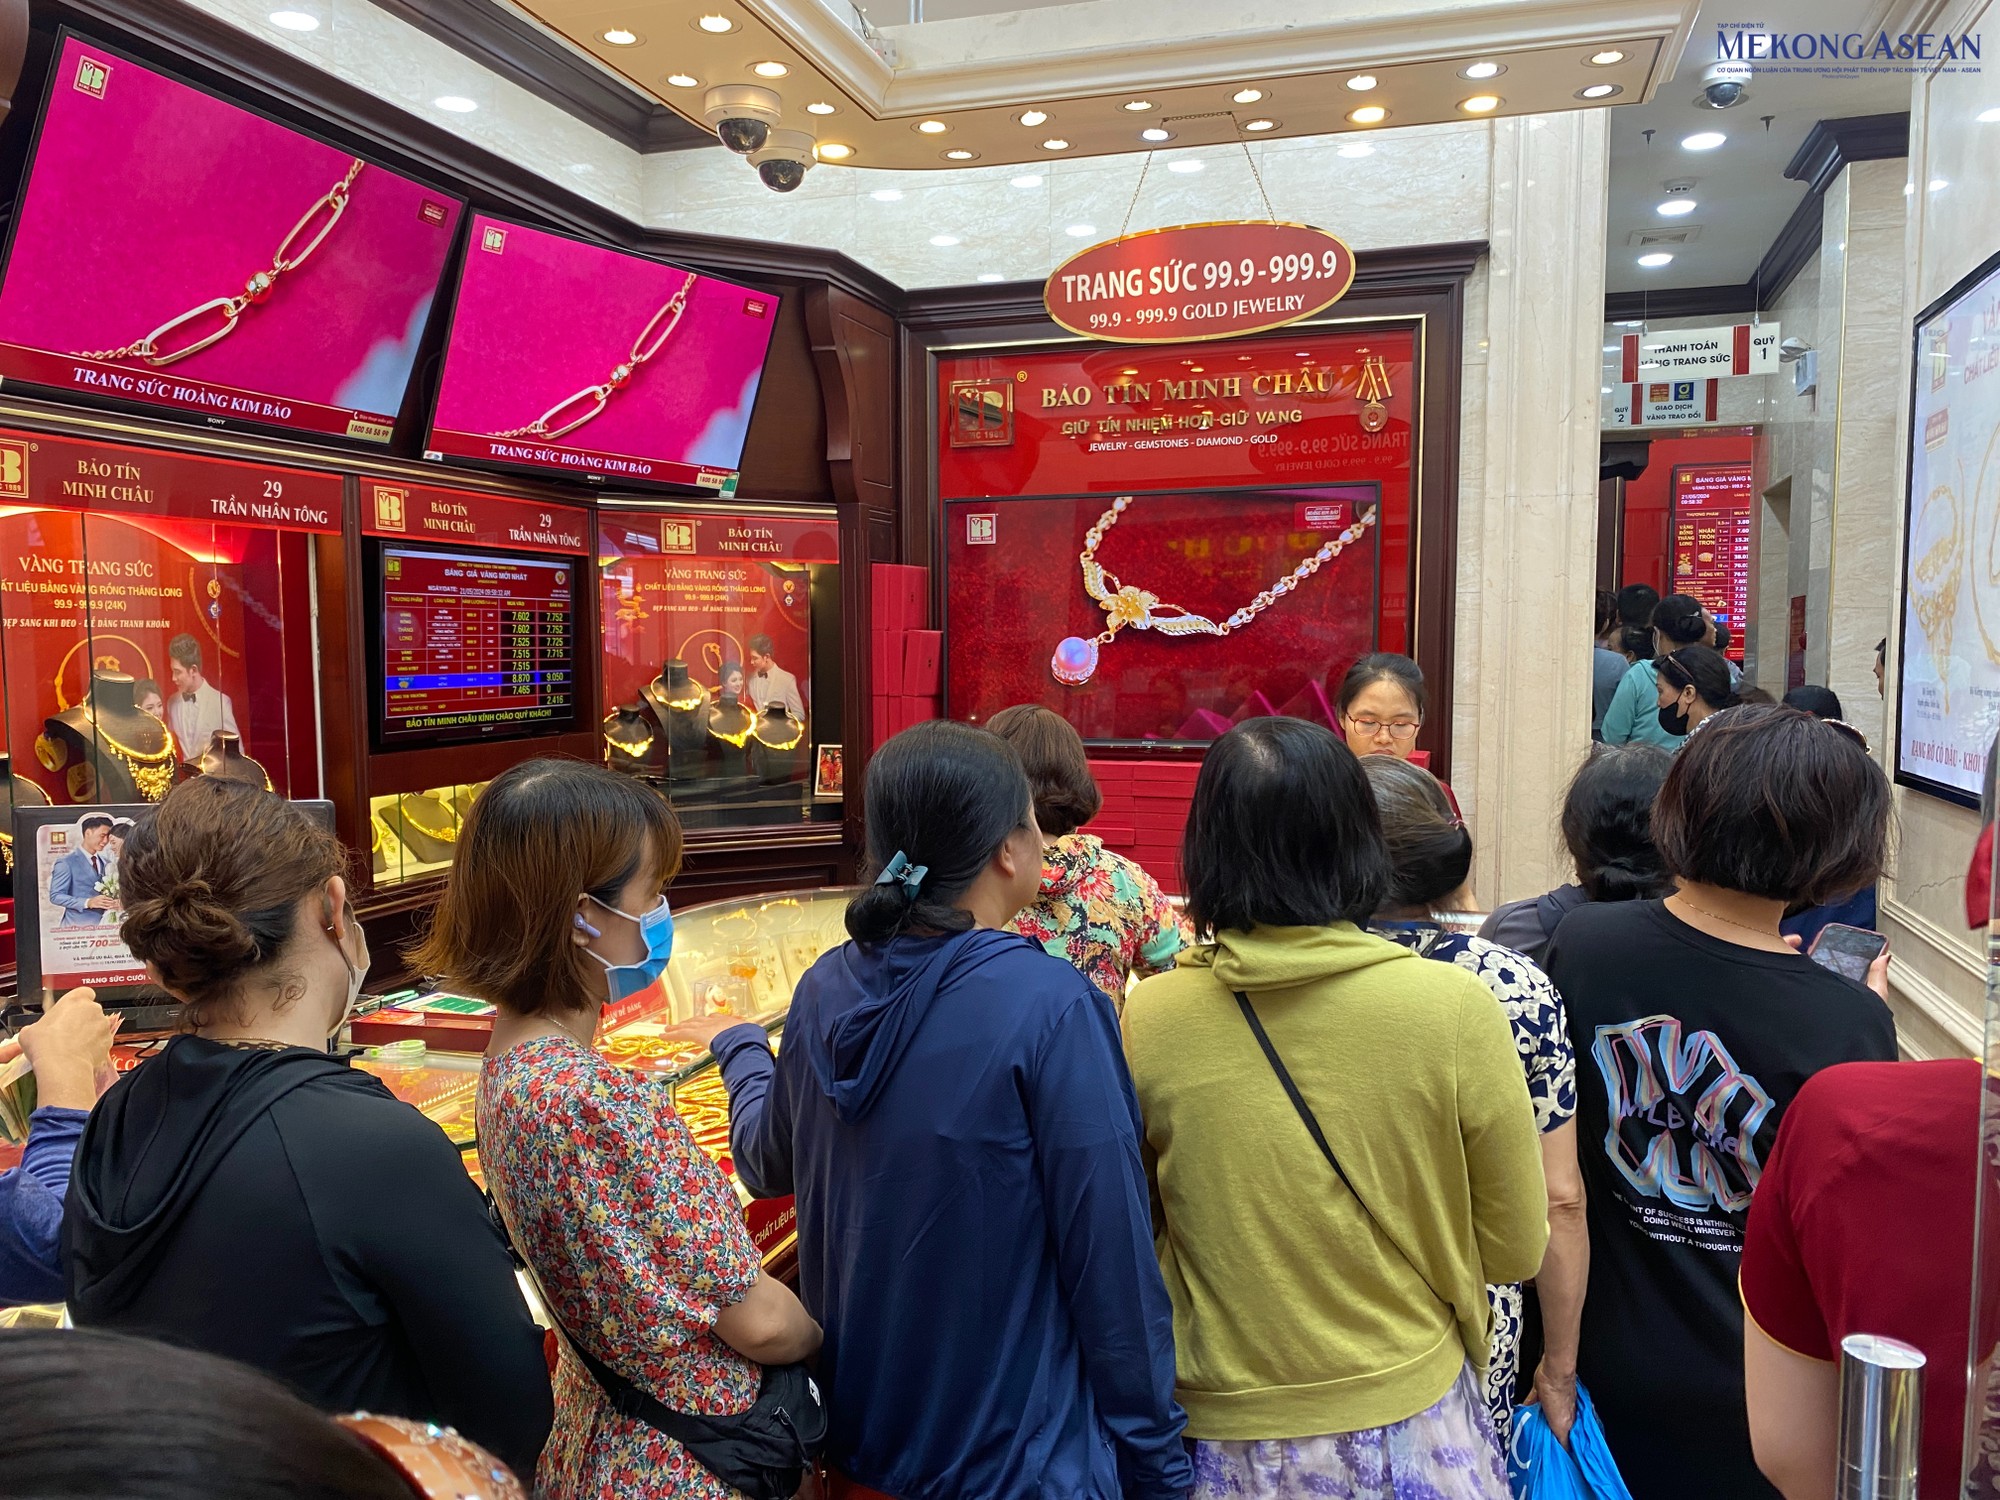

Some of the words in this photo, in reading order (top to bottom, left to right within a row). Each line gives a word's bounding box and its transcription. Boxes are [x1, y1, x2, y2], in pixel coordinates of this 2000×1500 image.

[1062, 268, 1143, 303] TRANG
[1149, 258, 1197, 295] SỨC
[1090, 312, 1121, 329] 99.9
[1136, 307, 1178, 325] 999.9
[1182, 302, 1228, 320] GOLD
[1232, 295, 1305, 318] JEWELRY
[1691, 341, 1718, 351] TOÁN
[1754, 336, 1775, 346] QUỸ
[1673, 357, 1707, 366] TRANG
[1710, 353, 1731, 363] SỨC
[1762, 348, 1767, 360] 1
[73, 367, 134, 391] TRANG
[136, 376, 171, 398] SỨC
[173, 385, 229, 408] HOÀNG
[230, 397, 261, 414] KIM
[264, 401, 292, 420] BẢO
[1041, 383, 1092, 408] BẢO
[1103, 379, 1151, 405] TÍN
[1163, 377, 1242, 401] MINH
[1252, 367, 1335, 396] CHÂU
[207, 417, 226, 425] SONY
[1219, 409, 1250, 426] GIỮ
[1618, 414, 1624, 422] 2
[1088, 441, 1127, 452] JEWELRY
[1134, 438, 1189, 450] GEMSTONES
[1196, 436, 1243, 447] DIAMOND
[1250, 434, 1278, 444] GOLD
[489, 443, 533, 459] TRANG
[534, 447, 559, 463] SỨC
[561, 454, 602, 468] HOÀNG
[604, 460, 626, 472] KIM
[629, 461, 652, 474] BẢO
[77, 458, 111, 477] BẢO
[114, 461, 141, 480] TÍN
[63, 480, 106, 500] MINH
[110, 485, 154, 504] CHÂU
[263, 480, 283, 499] 29
[211, 494, 247, 517] TRẦN
[251, 502, 290, 522] NHÂN
[293, 505, 328, 524] TÔNG
[431, 501, 450, 515] BẢO
[451, 503, 468, 516] TÍN
[424, 517, 450, 532] MINH
[450, 518, 476, 534] CHÂU
[539, 513, 552, 528] 29
[509, 525, 532, 542] TRẦN
[533, 529, 558, 544] NHÂN
[559, 531, 580, 548] TÔNG
[728, 526, 752, 538] BẢO
[753, 526, 773, 538] TÍN
[718, 541, 750, 552] MINH
[751, 540, 783, 553] CHÂU
[18, 554, 64, 574] VÀNG
[68, 559, 121, 576] TRANG
[125, 560, 154, 578] SỨC
[664, 566, 692, 579] VÀNG
[694, 569, 726, 580] TRANG
[728, 568, 747, 581] SỨC
[16, 580, 38, 595] LIỆU
[40, 580, 68, 594] BẰNG
[159, 588, 183, 598] LONG
[54, 600, 72, 609] 99.9
[105, 600, 127, 612] (24K)
[20, 618, 42, 628] SANG
[43, 618, 58, 628] KHI
[98, 618, 118, 628] DÀNG
[119, 619, 144, 628] THANH
[423, 716, 436, 726] TÍN
[437, 715, 457, 726] MINH
[458, 712, 478, 724] CHÂU
[478, 712, 495, 722] KÍNH
[496, 710, 514, 721] CHÀO
[89, 940, 108, 948] 700
[109, 974, 124, 983] SỨC
[126, 973, 146, 982] CƯỚI
[1645, 1208, 1656, 1216] OF
[1658, 1210, 1694, 1225] SUCCESS
[1696, 1218, 1702, 1226] IS
[755, 1220, 774, 1246] CHẤT
[774, 1211, 789, 1232] LIỆU
[1643, 1216, 1670, 1226] DOING
[1671, 1220, 1694, 1233] WELL
[1694, 1226, 1736, 1237] WHATEVER
[1649, 1232, 1686, 1243] WITHOUT
[1688, 1238, 1694, 1246] A
[1695, 1240, 1732, 1252] THOUGHT
